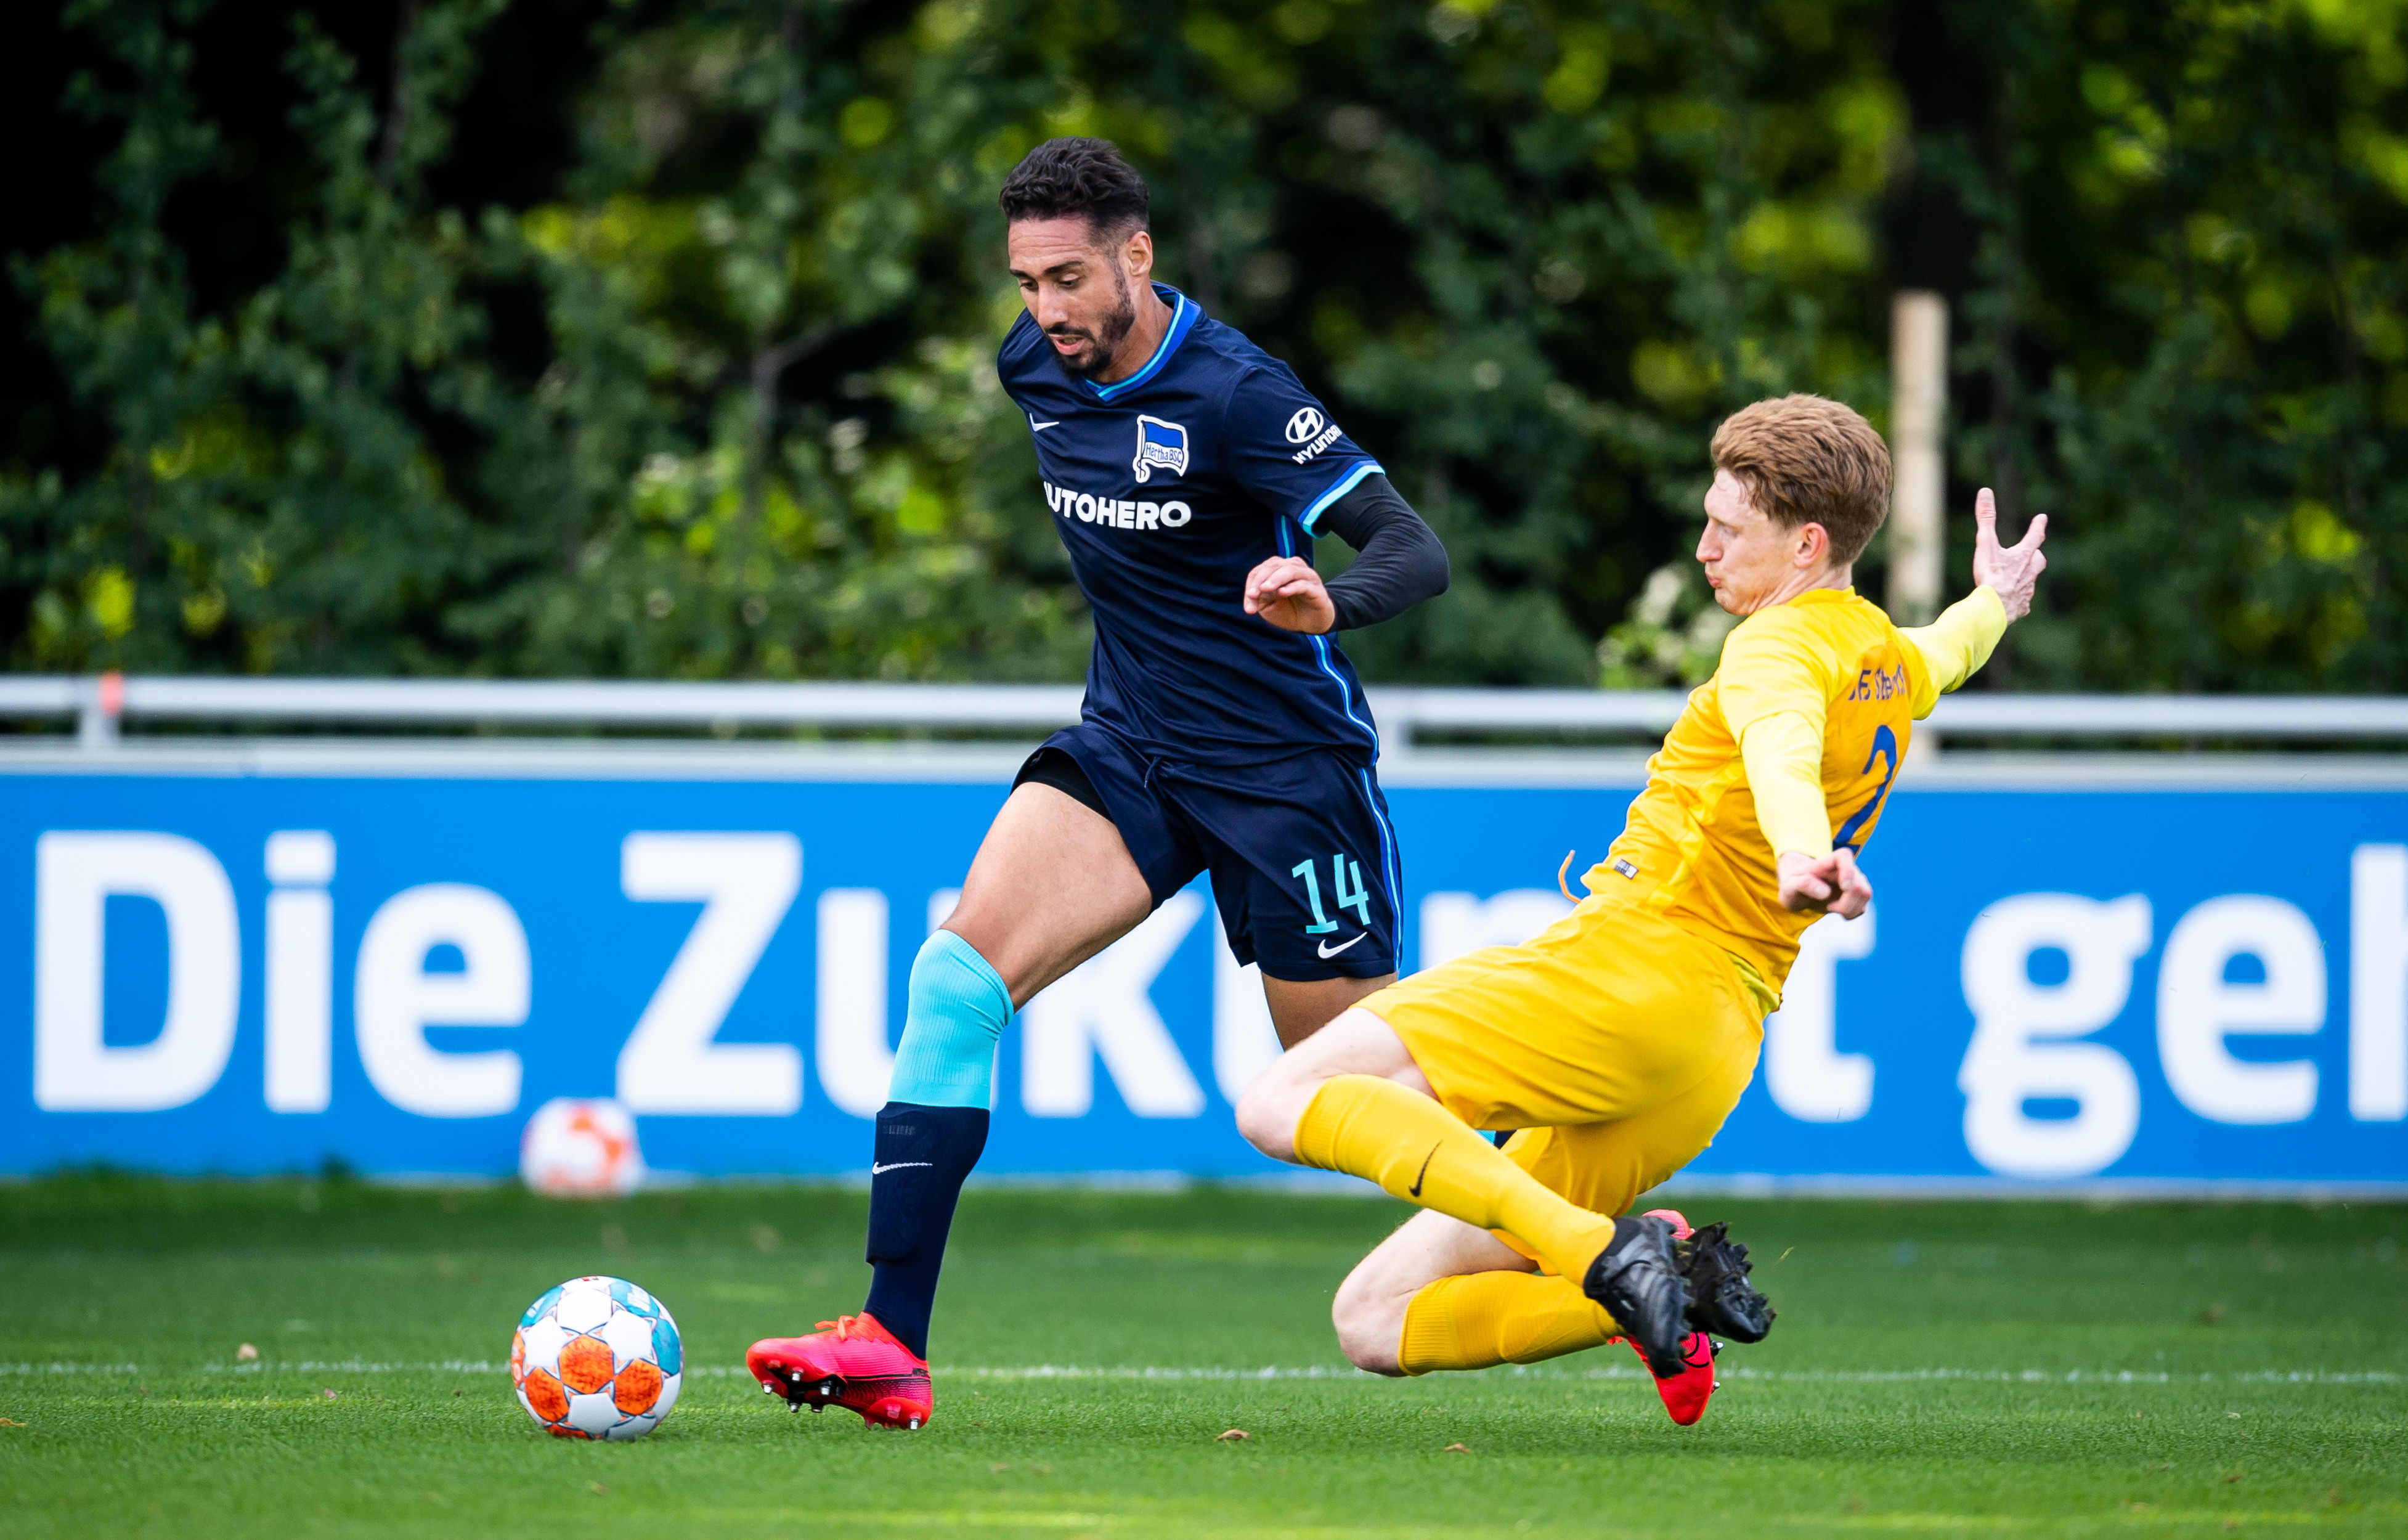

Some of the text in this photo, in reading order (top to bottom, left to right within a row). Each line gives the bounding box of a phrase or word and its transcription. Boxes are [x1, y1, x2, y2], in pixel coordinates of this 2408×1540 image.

[1145, 444, 1182, 463] Hertha BSC
[1832, 724, 1898, 857] 2
[1292, 853, 1372, 934] 14
[33, 829, 532, 1118] Die
